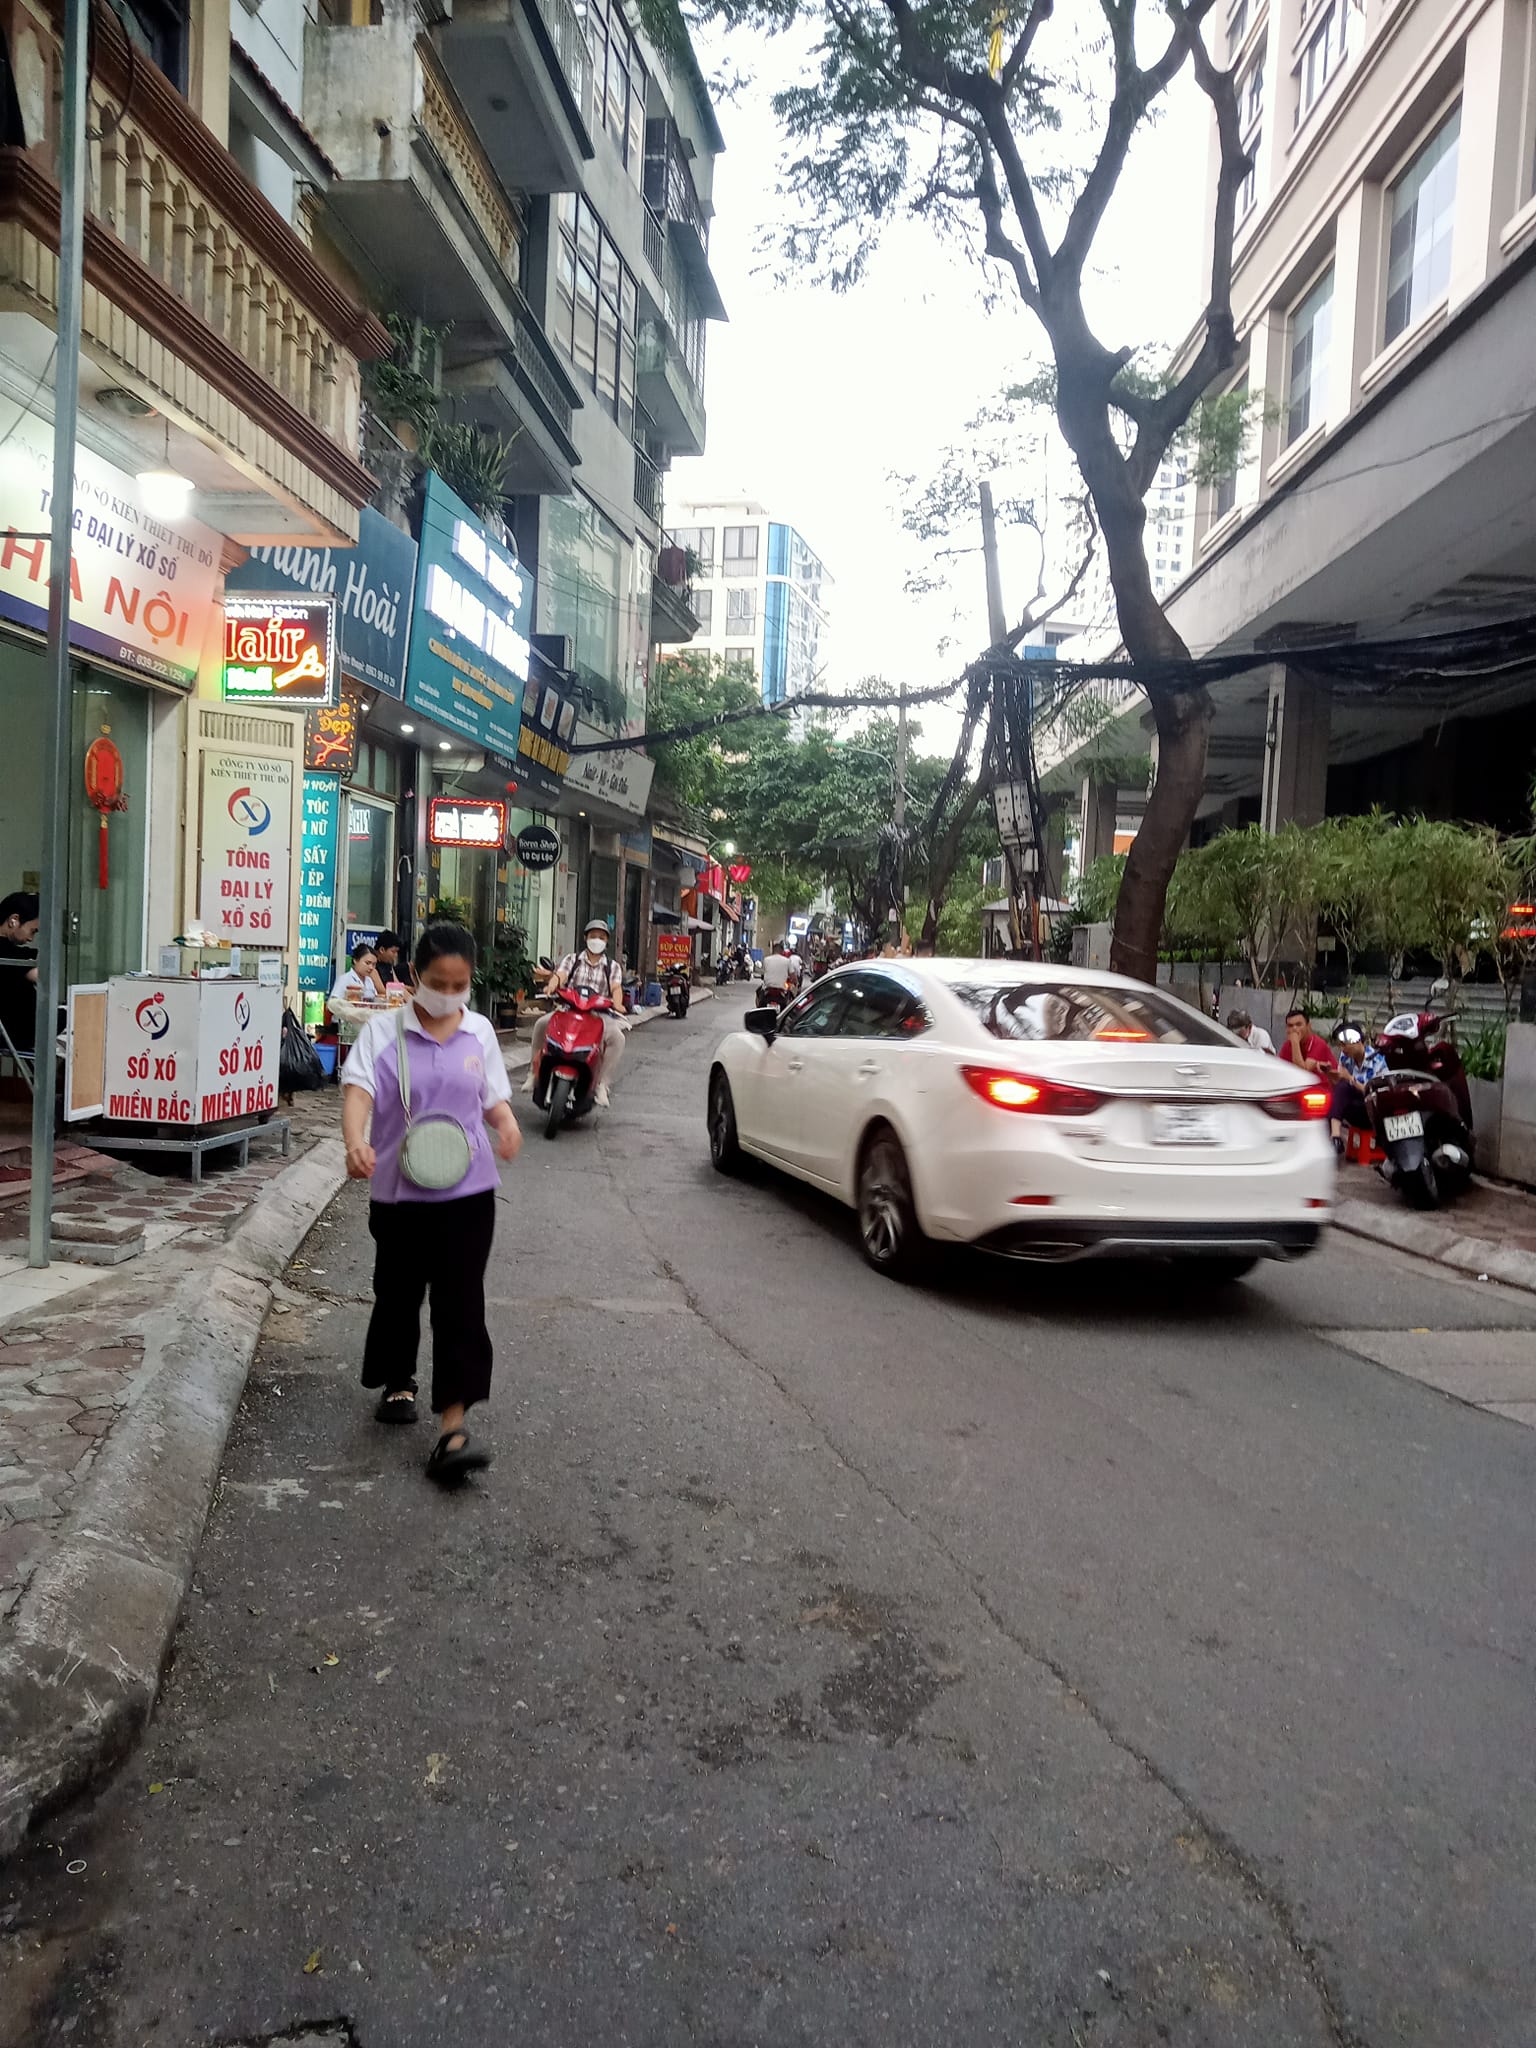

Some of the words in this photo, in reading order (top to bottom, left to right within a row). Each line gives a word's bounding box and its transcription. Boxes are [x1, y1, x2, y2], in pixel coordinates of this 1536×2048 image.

[40, 487, 84, 532] TG
[87, 515, 114, 549] ĐẠI
[116, 531, 136, 558] LÝ
[136, 542, 160, 571] XỔ
[158, 554, 180, 581] SỐ
[250, 546, 338, 592] hanh
[342, 559, 402, 640] Hoài
[103, 575, 190, 648] NỘI
[219, 757, 244, 769] CÔNG
[245, 761, 256, 771] TY
[233, 769, 259, 782] THIẾT
[306, 796, 330, 816] TÓC
[310, 818, 329, 837] NỮ
[225, 843, 271, 870] TỔNG
[303, 843, 329, 865] SẤY
[220, 879, 249, 902] ĐẠI
[254, 878, 274, 900] LÝ
[307, 867, 325, 887] ÉP
[221, 903, 245, 928] XỔ
[250, 905, 273, 930] SỐ
[126, 1047, 152, 1080] SỔ
[153, 1051, 178, 1082] XỐ
[218, 1036, 242, 1077] SỔ
[243, 1035, 265, 1073] XỐ
[109, 1088, 152, 1120] MIỀN
[156, 1090, 191, 1123] BẮC
[201, 1082, 242, 1123] MIỀN
[245, 1075, 275, 1114] BẮC
